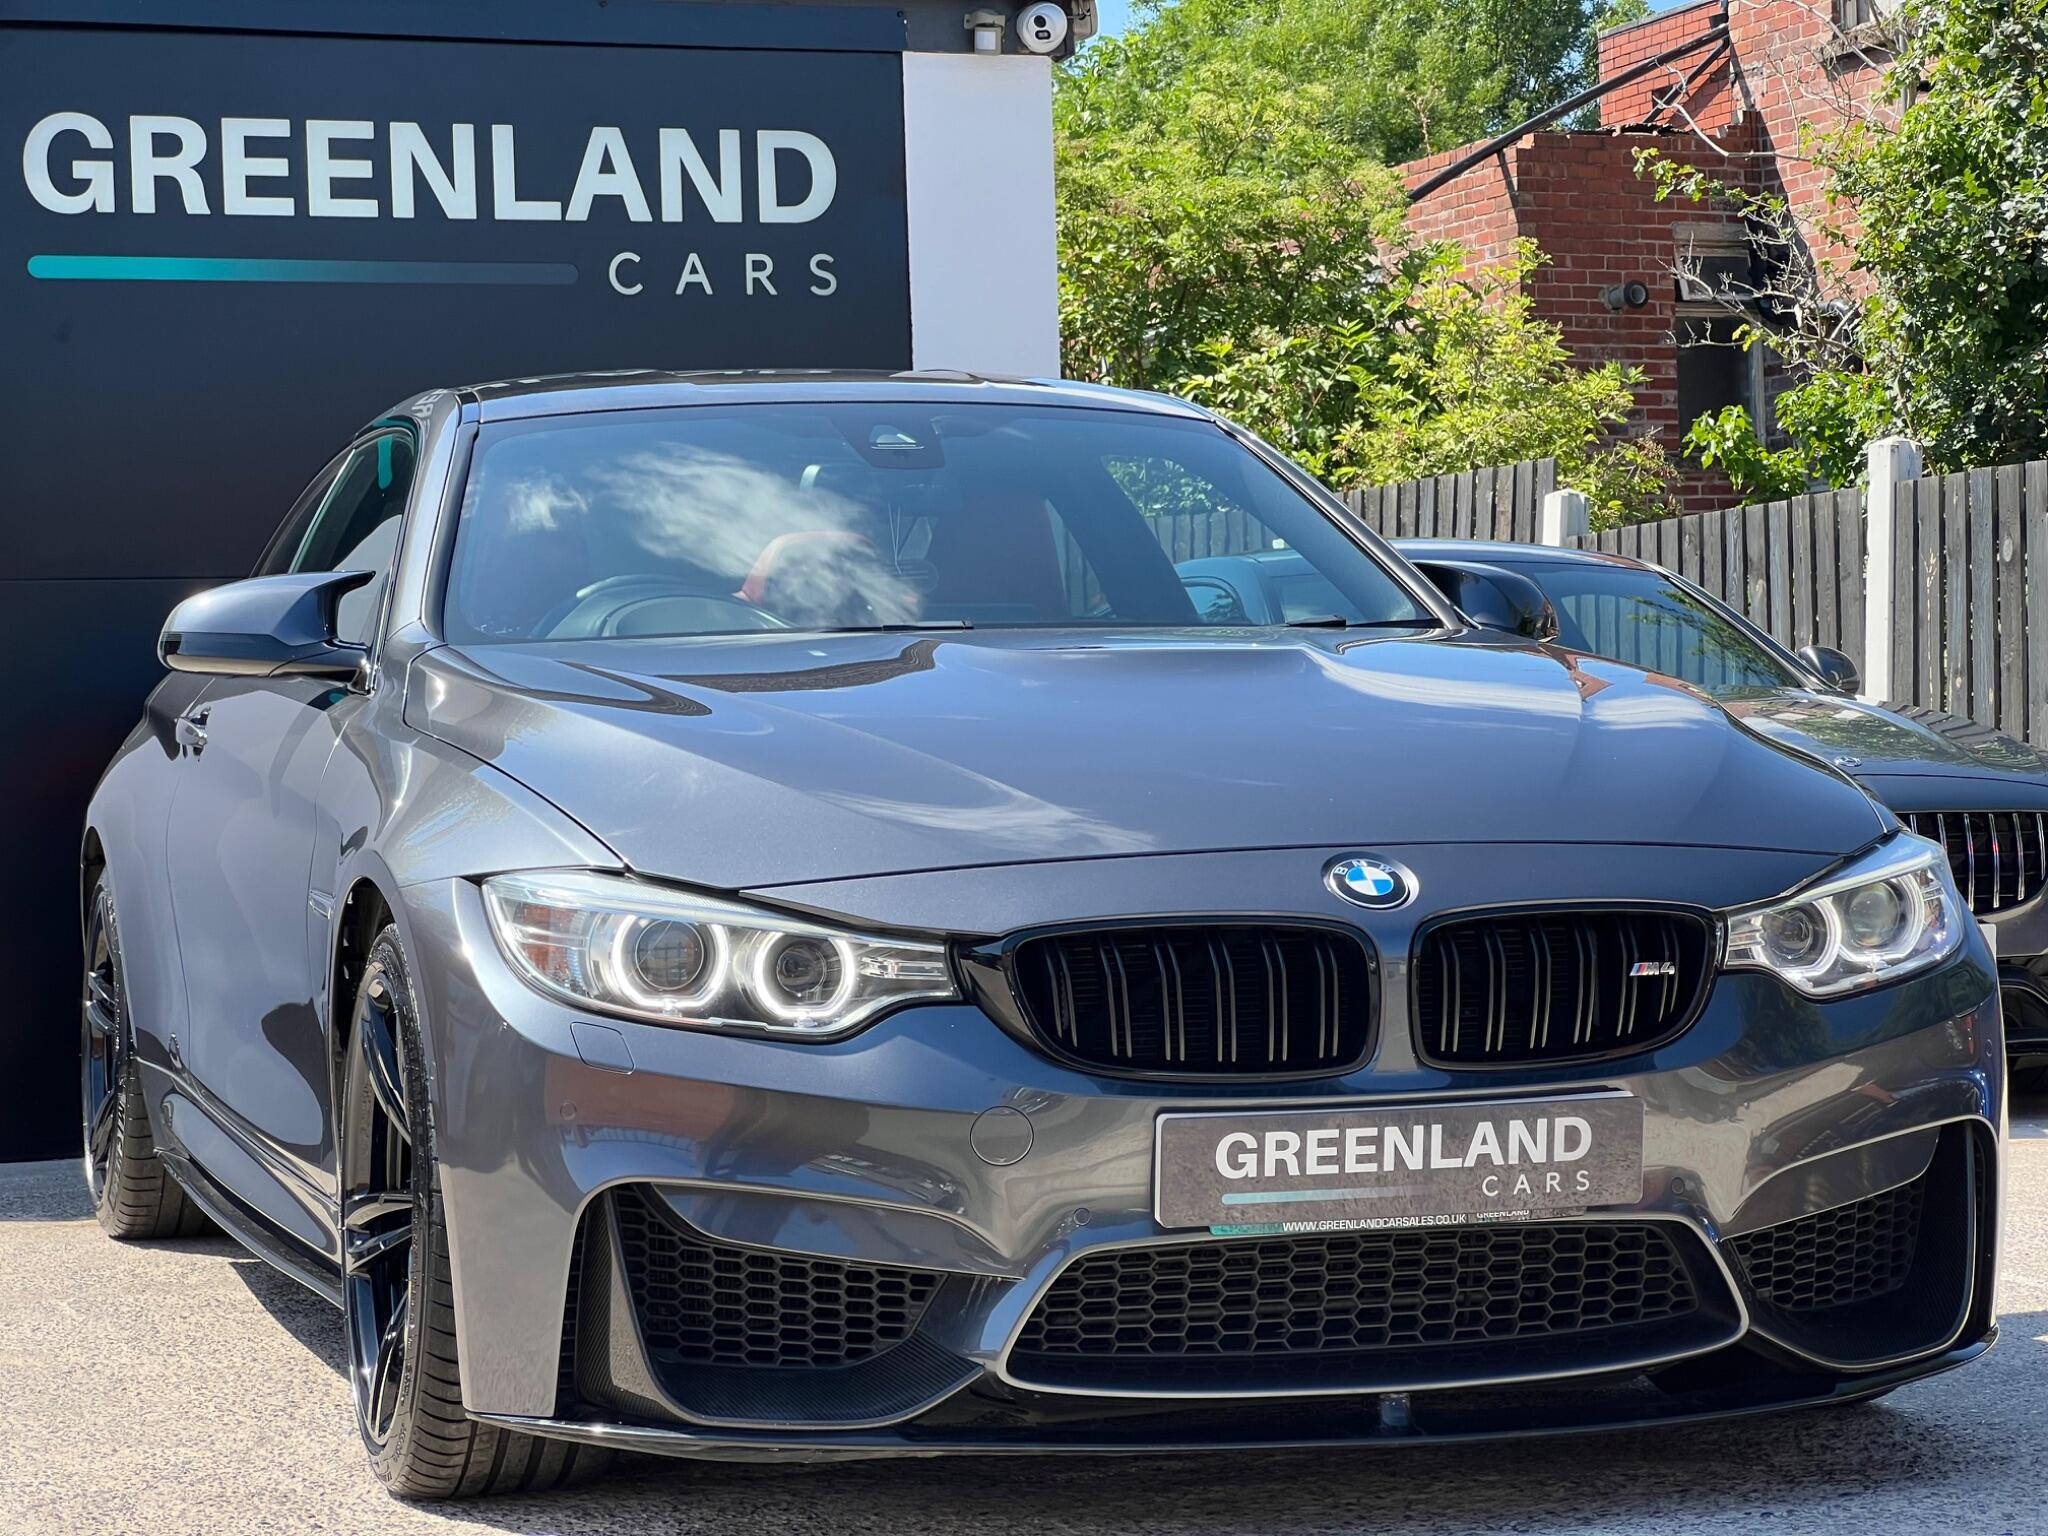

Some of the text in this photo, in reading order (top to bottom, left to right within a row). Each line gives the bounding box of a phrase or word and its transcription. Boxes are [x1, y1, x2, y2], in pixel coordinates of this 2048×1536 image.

[22, 111, 839, 223] GREENLAND
[608, 252, 838, 297] CARS
[1334, 859, 1394, 876] BMW
[1641, 961, 1676, 976] M4
[1215, 1116, 1594, 1180] GREENLAND
[1482, 1170, 1591, 1198] CARS
[1283, 1213, 1467, 1232] WWW.GREENLANDCARSALES.CO.UK
